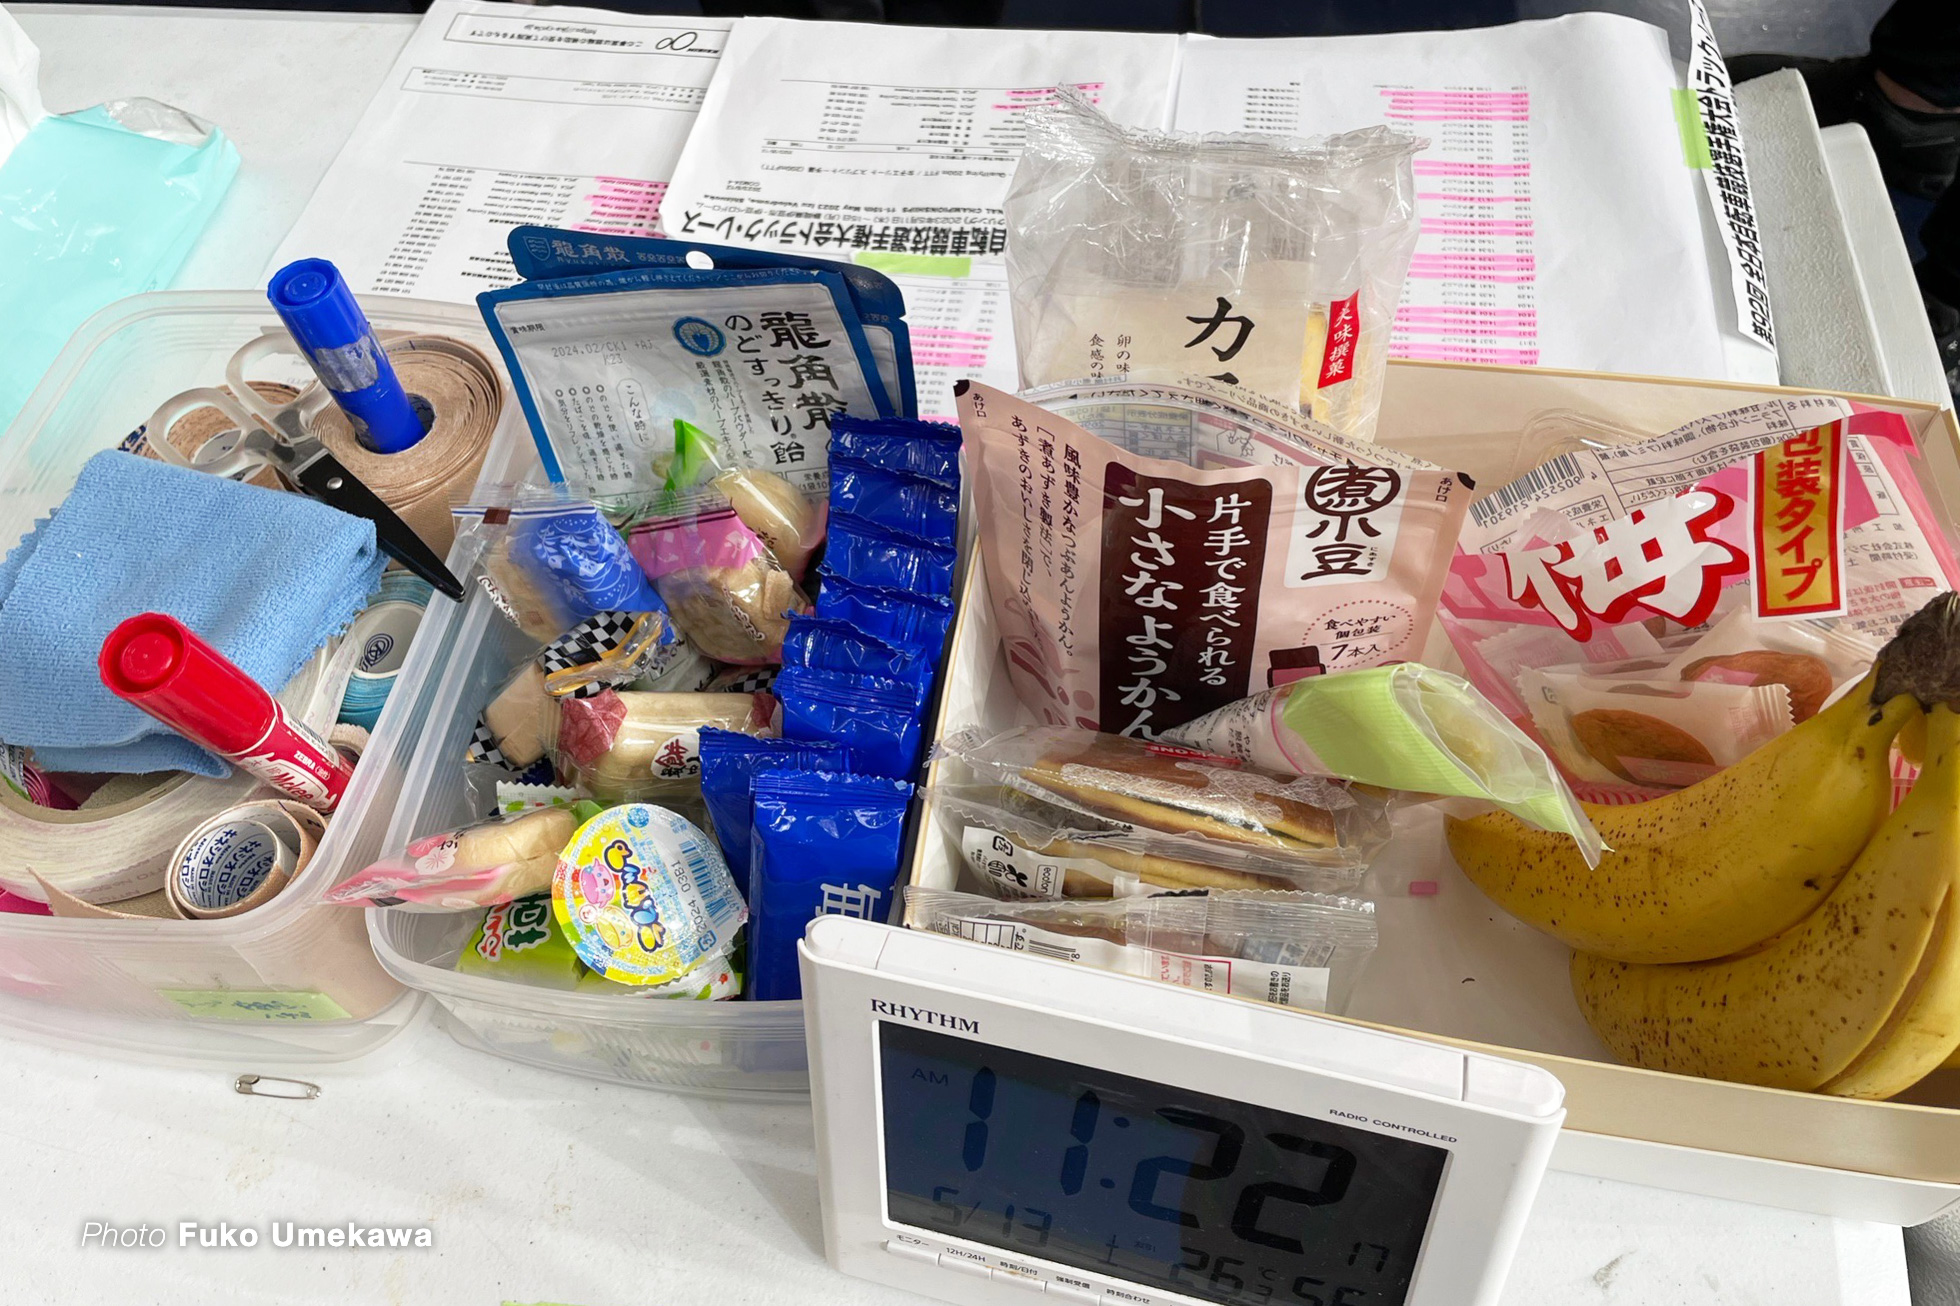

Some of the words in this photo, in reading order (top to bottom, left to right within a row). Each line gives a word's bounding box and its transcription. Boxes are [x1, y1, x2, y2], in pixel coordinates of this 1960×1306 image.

[680, 211, 1007, 256] 自転車競技選手権大会トラック・レース
[510, 323, 545, 334] 賞味期限
[1116, 334, 1131, 374] 卵の味
[625, 384, 649, 443] こんな時に
[972, 392, 988, 418] あけ口
[1435, 476, 1453, 503] あけ口
[1197, 493, 1252, 687] 片手で食べられる
[1118, 487, 1197, 740] 小さなようかん
[1324, 613, 1397, 631] 食べやすい
[1335, 624, 1382, 640] 個包装
[1331, 643, 1381, 662] 7本入
[293, 750, 316, 769] ZEBRA
[869, 998, 981, 1035] RHYTHM
[910, 1067, 950, 1086] AM
[1328, 1108, 1369, 1123] RADIO
[1372, 1118, 1458, 1144] CONTROLLED
[962, 1066, 1358, 1255] 11:22
[930, 1185, 1053, 1248] 5/13
[895, 1233, 931, 1247] モニター
[945, 1246, 986, 1263] 12H/24H
[999, 1260, 1038, 1276] 時刻/日付
[1055, 1275, 1091, 1290] 強制受信
[1105, 1287, 1151, 1305] 時刻合わせ
